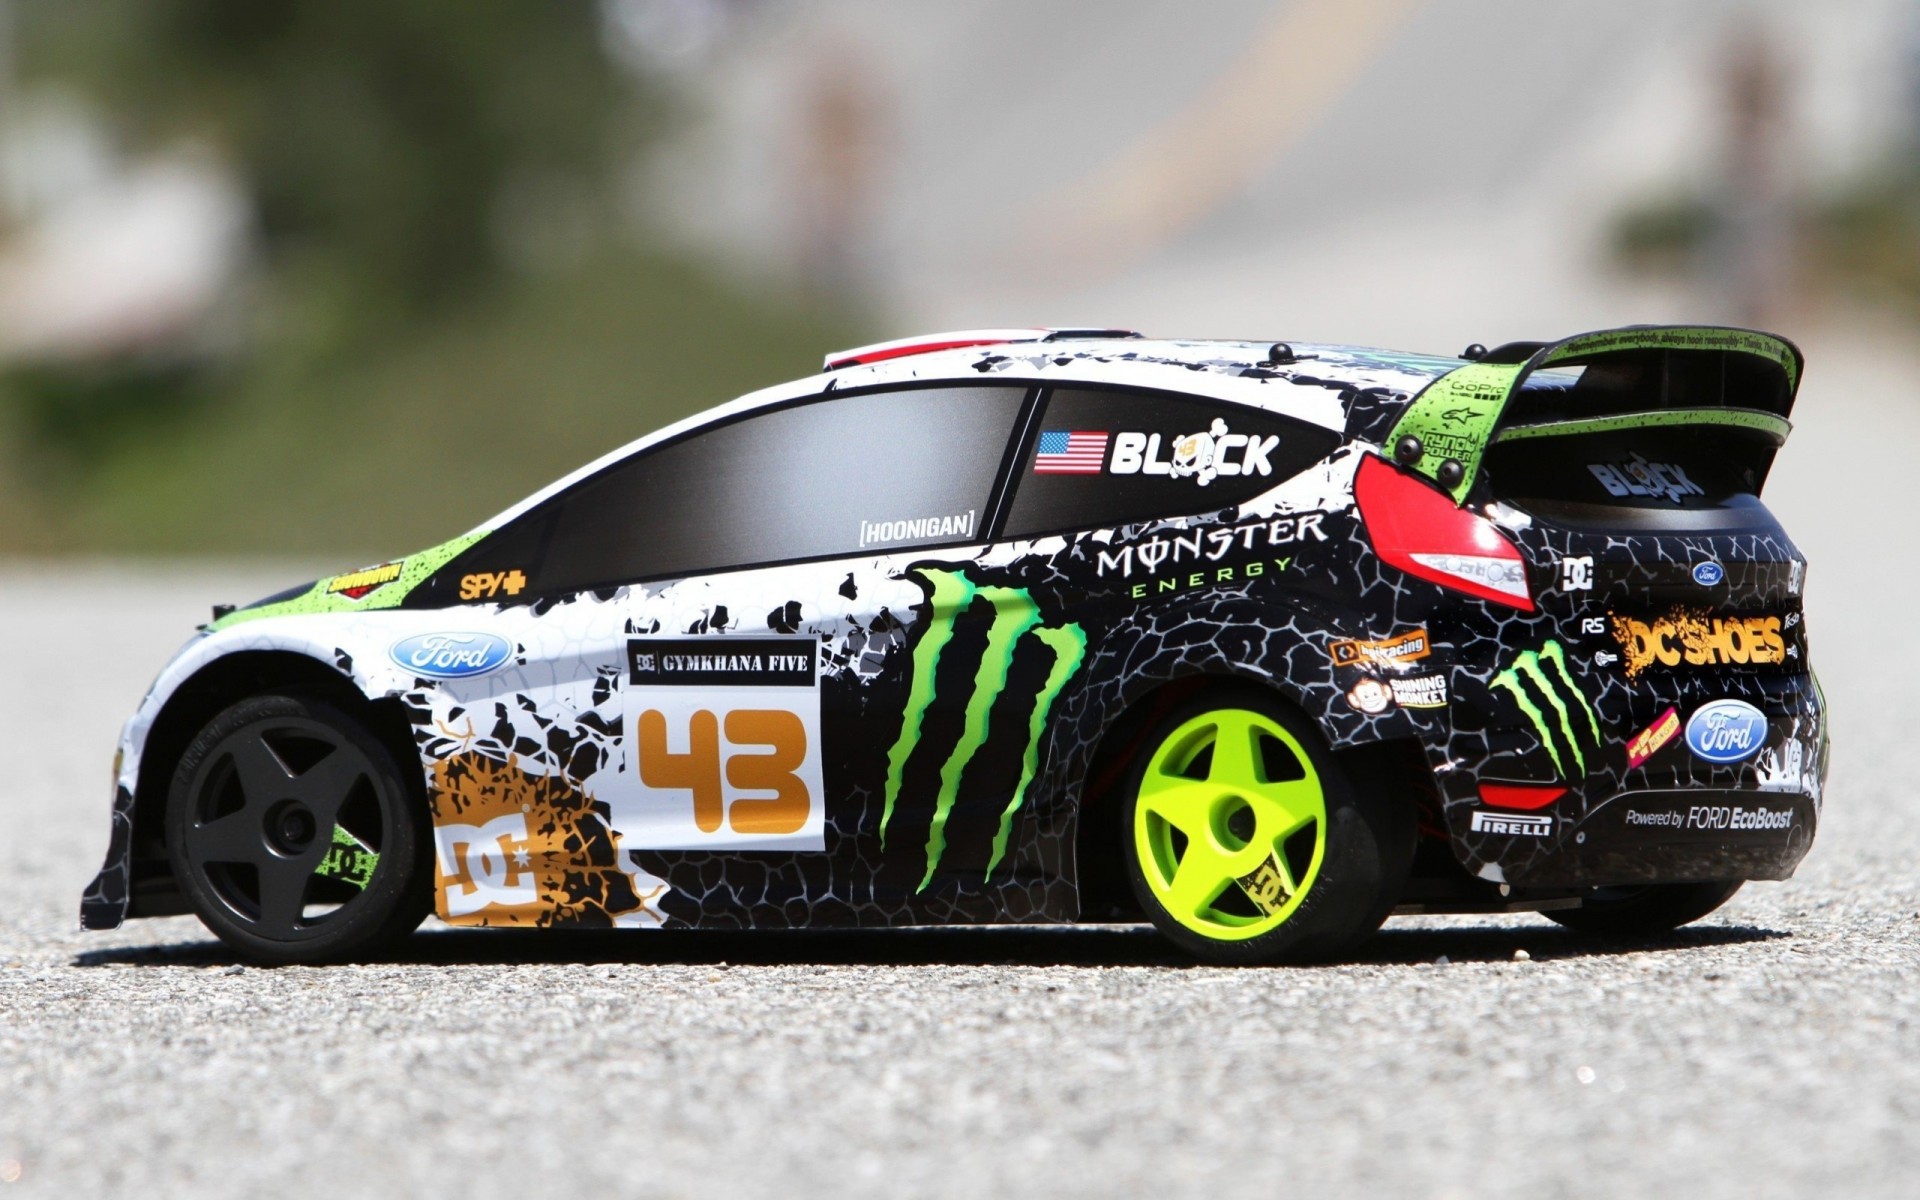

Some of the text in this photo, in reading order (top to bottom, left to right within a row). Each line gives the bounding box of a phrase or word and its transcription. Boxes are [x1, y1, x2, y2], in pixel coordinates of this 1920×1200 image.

[1451, 381, 1506, 394] GoPro
[1423, 446, 1473, 463] POWER
[1132, 557, 1292, 598] ENERGY
[1562, 556, 1595, 591] DC
[1699, 566, 1717, 581] Ford
[1581, 617, 1605, 634] RS
[411, 634, 493, 669] Ford
[662, 653, 763, 672] GYMKHANA
[768, 654, 809, 673] FIVE
[1389, 674, 1447, 692] SHINING
[1393, 688, 1447, 704] MONKEY
[1701, 710, 1754, 752] Ford
[637, 709, 811, 834] 43
[1470, 811, 1553, 836] PIRELLI
[1626, 806, 1794, 830] Powered by FORD EcoBoost
